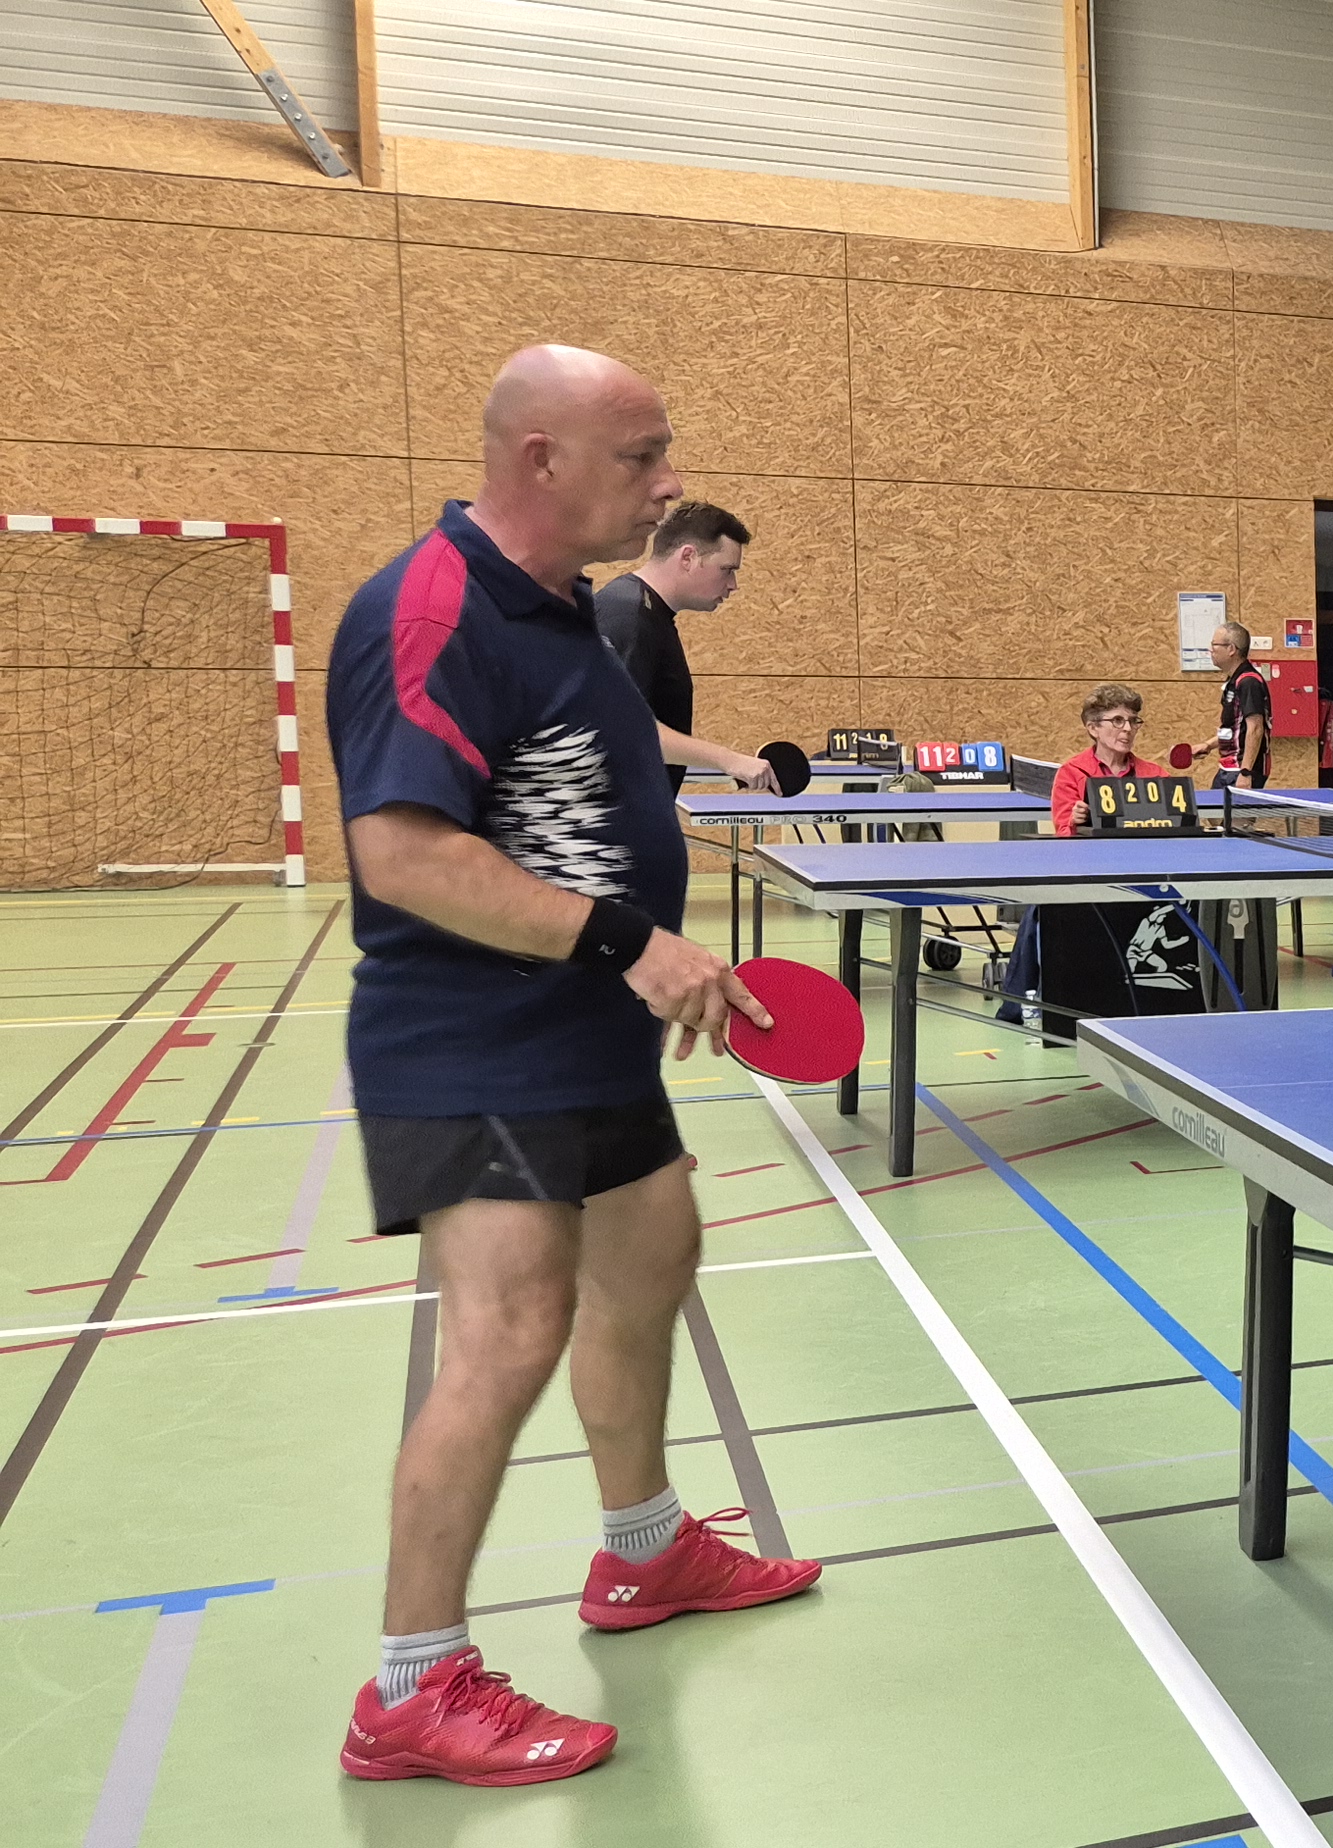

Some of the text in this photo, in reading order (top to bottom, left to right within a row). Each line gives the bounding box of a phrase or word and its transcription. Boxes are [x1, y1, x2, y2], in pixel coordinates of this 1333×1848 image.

[834, 733, 847, 750] 11
[851, 732, 858, 744] 2
[920, 746, 997, 767] 11 2 0 8
[1099, 782, 1186, 814] 8 2 0 4
[812, 815, 847, 823] 340
